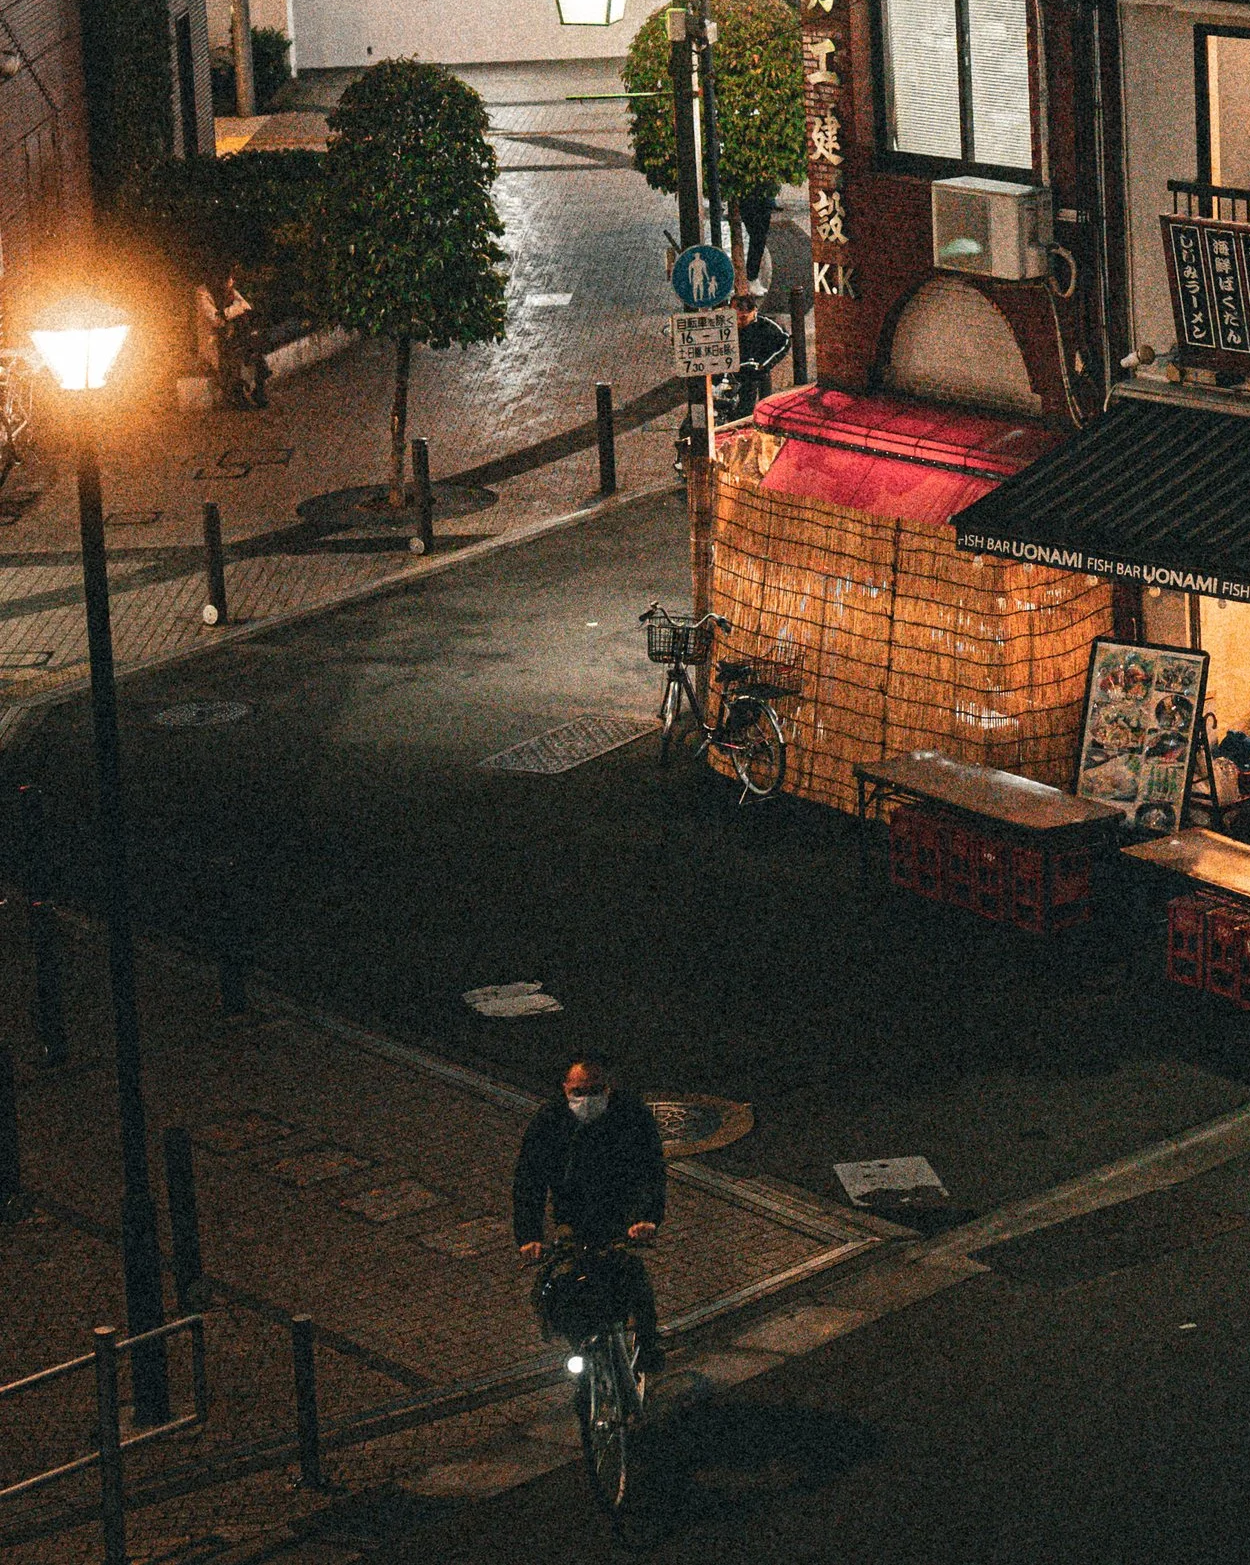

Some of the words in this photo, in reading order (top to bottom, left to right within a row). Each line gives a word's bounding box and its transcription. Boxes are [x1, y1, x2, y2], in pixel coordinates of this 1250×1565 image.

[681, 331, 694, 345] 16
[719, 328, 732, 341] 19
[725, 357, 733, 369] 9
[986, 537, 1010, 554] BAR
[1012, 540, 1083, 569] UONAMI
[1087, 557, 1114, 574] FISH
[1116, 562, 1141, 579] BAR
[1142, 564, 1218, 594] UONAMI
[1222, 581, 1250, 599] FISH
